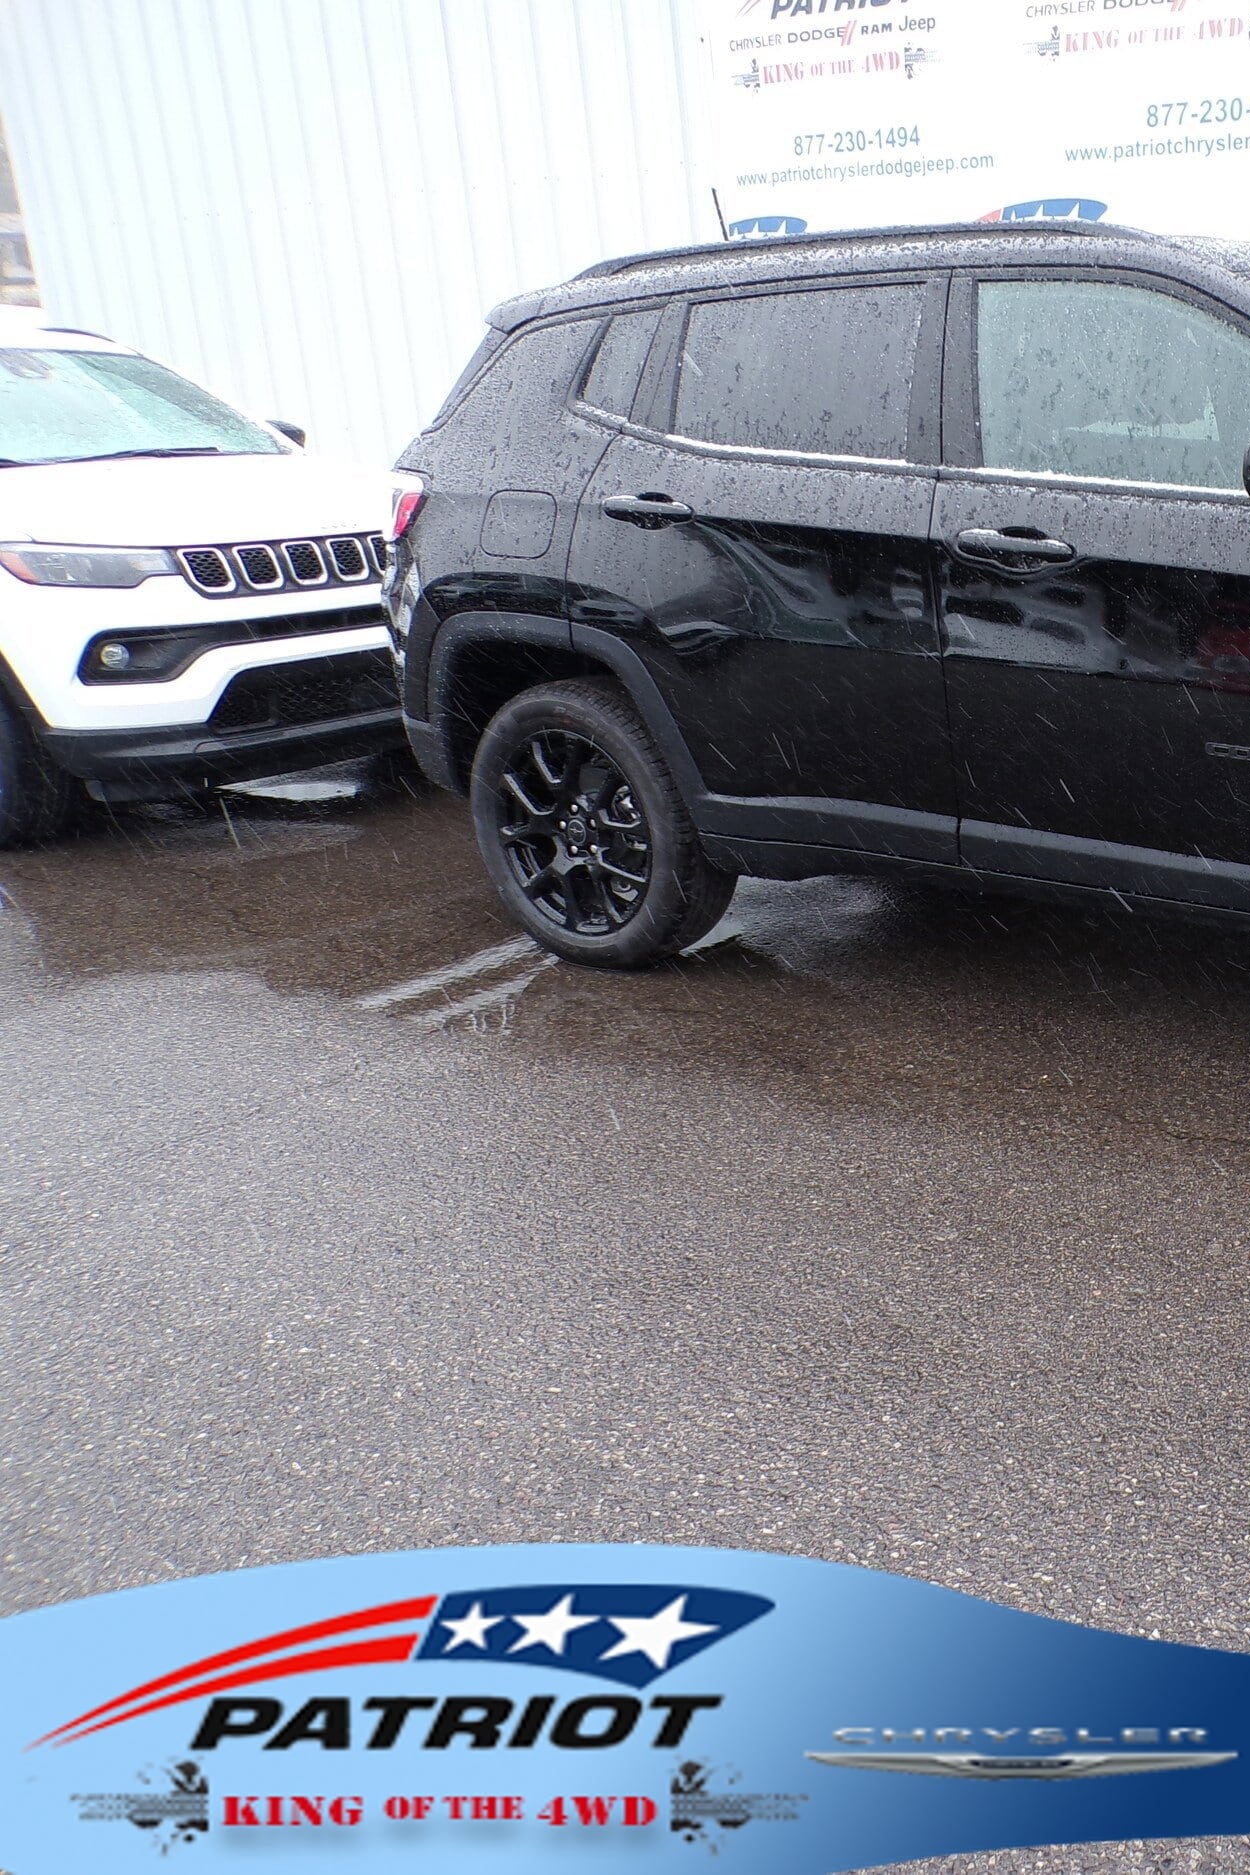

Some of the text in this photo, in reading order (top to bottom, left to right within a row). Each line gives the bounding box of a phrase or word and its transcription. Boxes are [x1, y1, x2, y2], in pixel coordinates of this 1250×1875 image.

[1026, 0, 1095, 18] CHRYSLER
[729, 15, 936, 51] CHRYSLER DODGE RAM Jeep
[762, 62, 804, 84] KING
[793, 125, 921, 156] 877-230-1494
[736, 153, 994, 188] www.patriotchryslerdodgejeep.com
